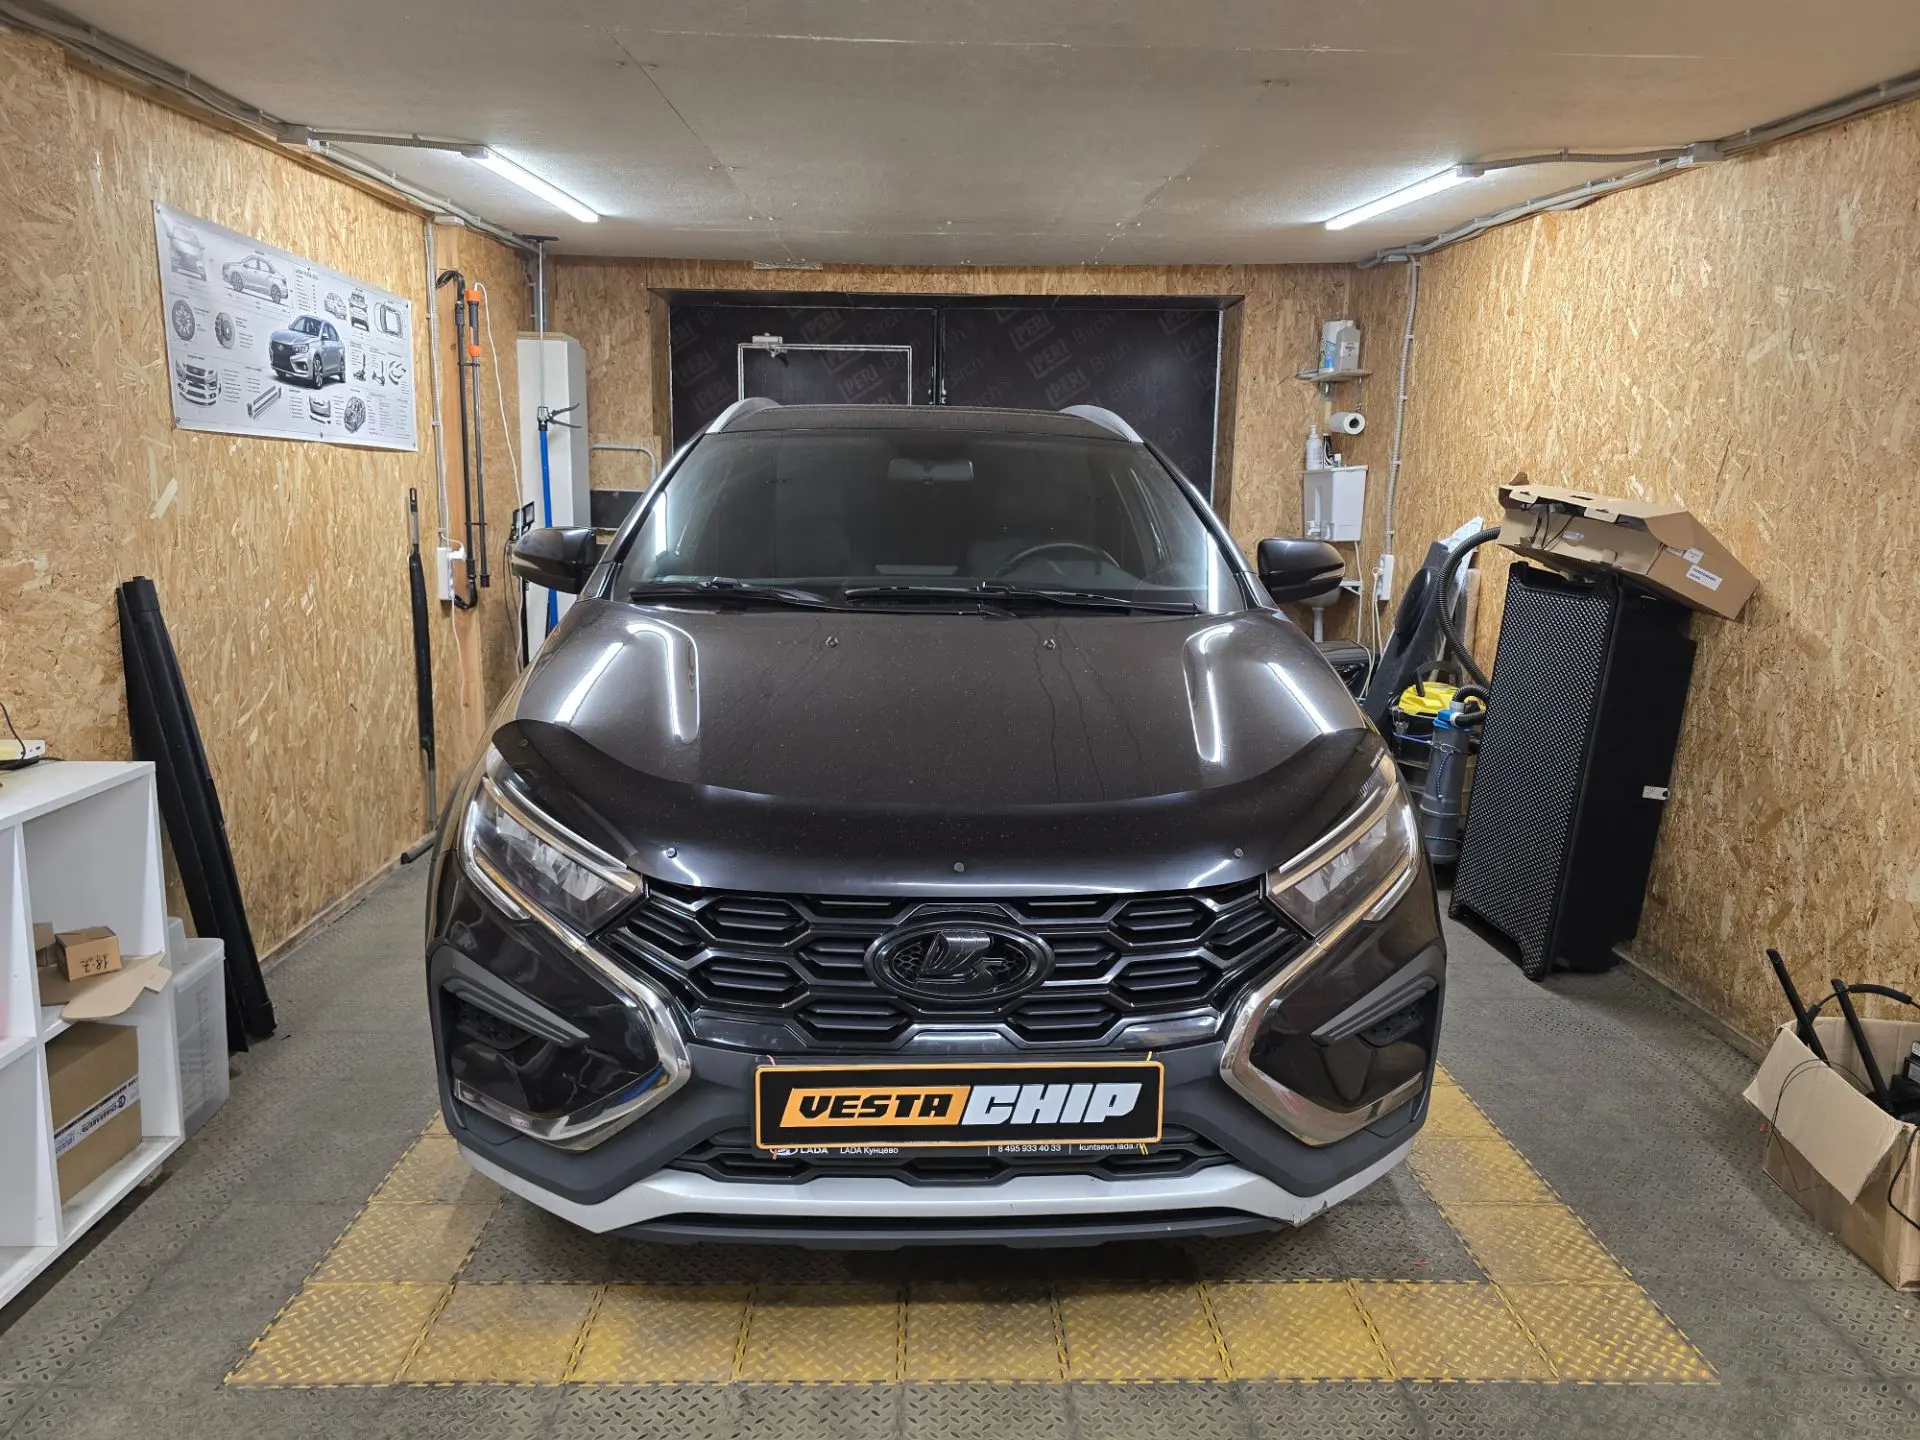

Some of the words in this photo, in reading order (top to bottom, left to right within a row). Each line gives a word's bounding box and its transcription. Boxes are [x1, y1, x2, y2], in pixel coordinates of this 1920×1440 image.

[798, 1093, 953, 1119] VESTA
[961, 1083, 1142, 1125] CHIP
[863, 1147, 899, 1156] Кунцево
[997, 1144, 1003, 1152] 8
[1005, 1144, 1021, 1152] 495
[1022, 1144, 1037, 1152] 933
